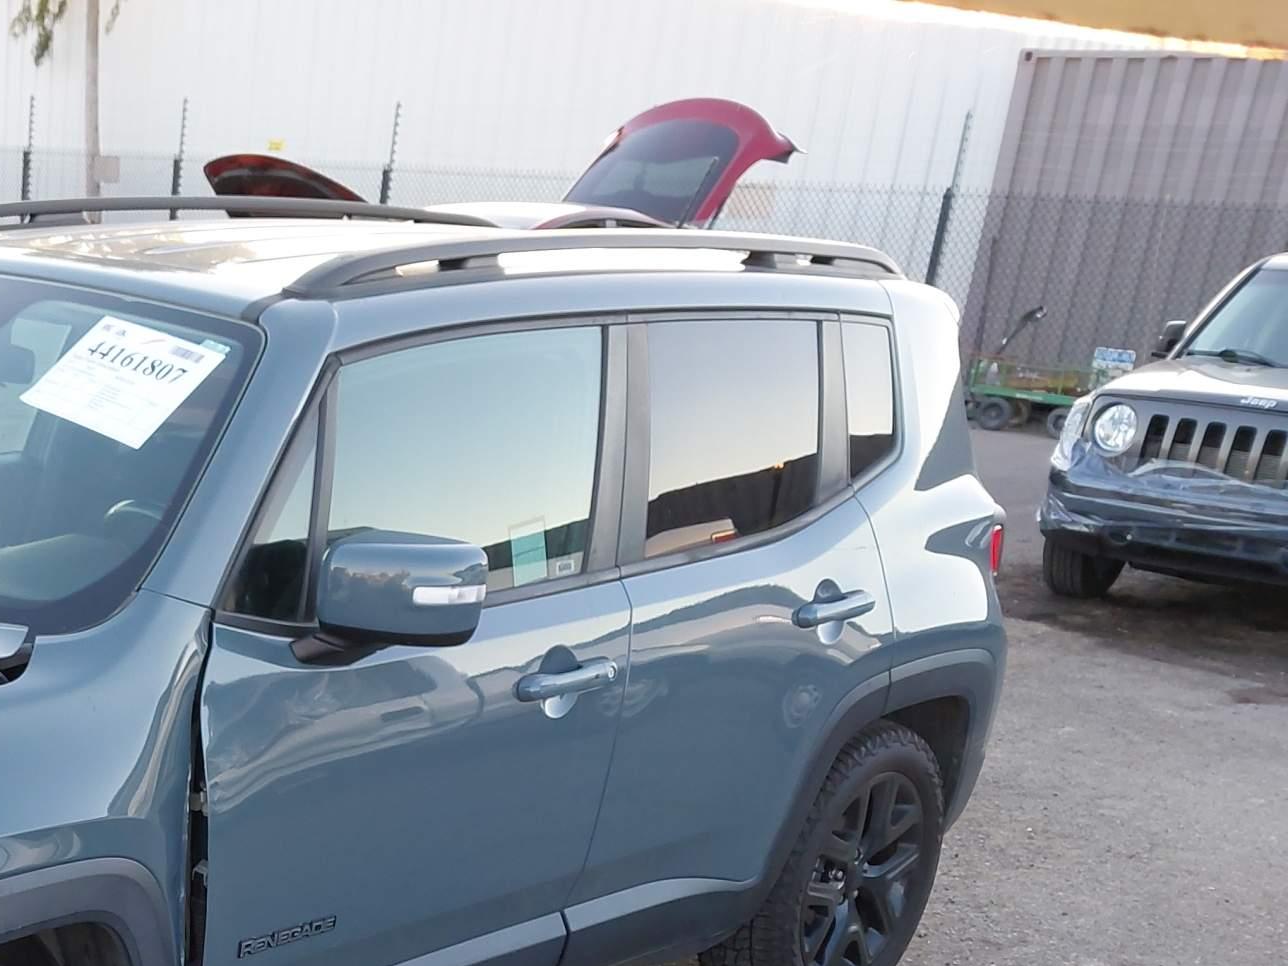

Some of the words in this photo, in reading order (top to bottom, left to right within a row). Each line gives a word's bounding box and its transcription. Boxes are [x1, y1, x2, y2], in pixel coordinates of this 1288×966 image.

[88, 341, 188, 384] 44161807
[1240, 396, 1278, 410] Jeep
[237, 915, 337, 959] RENEGADE
